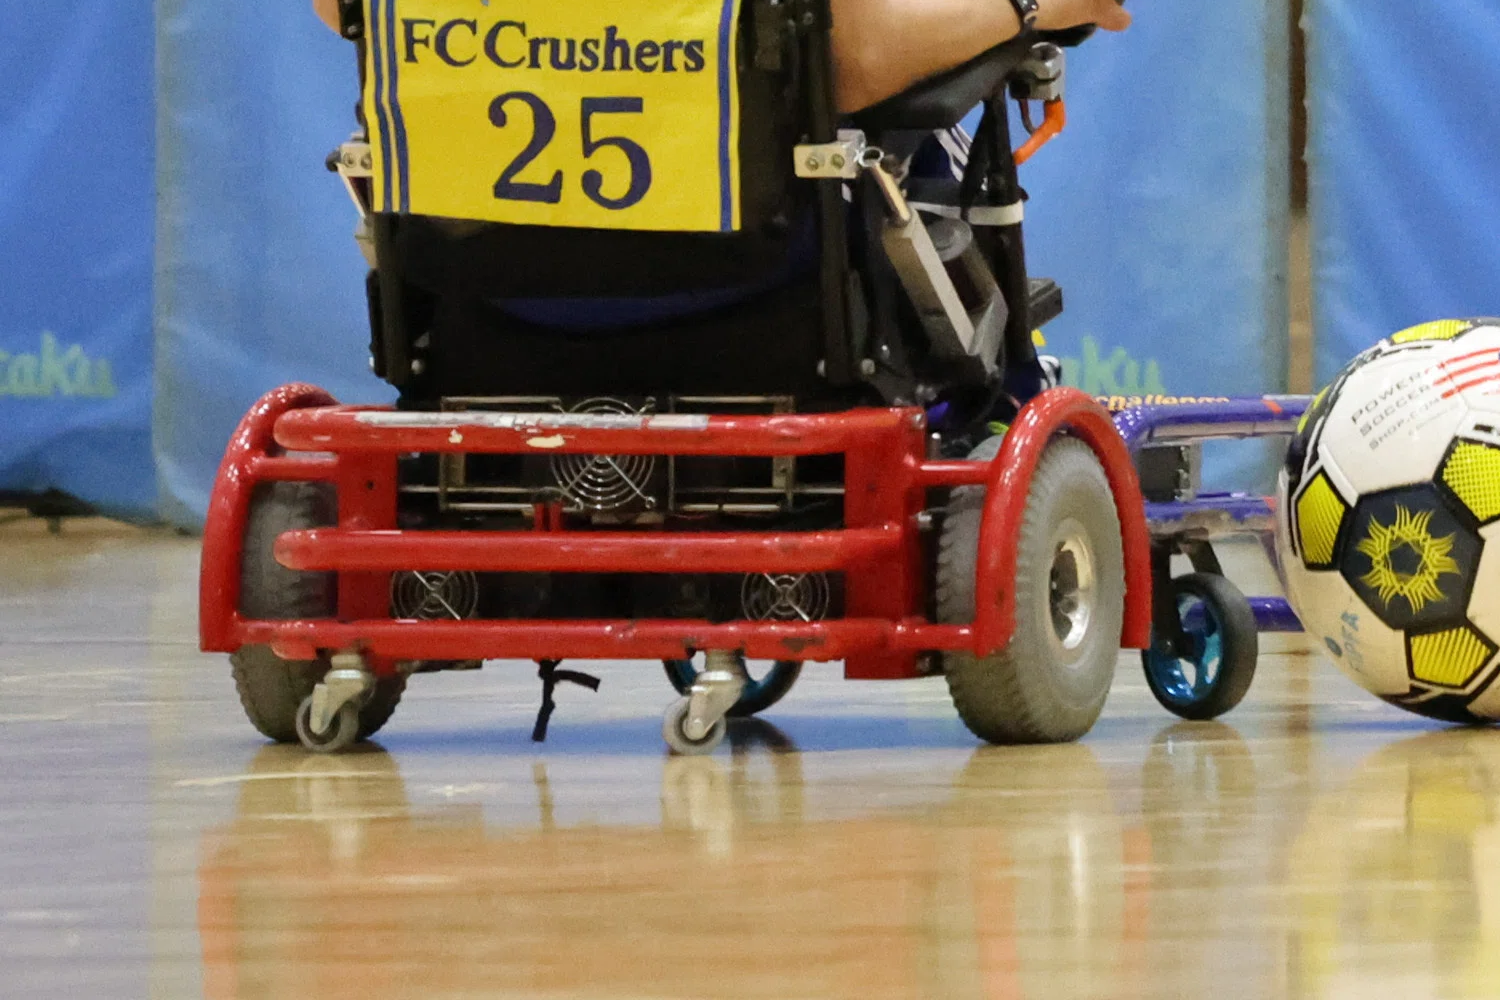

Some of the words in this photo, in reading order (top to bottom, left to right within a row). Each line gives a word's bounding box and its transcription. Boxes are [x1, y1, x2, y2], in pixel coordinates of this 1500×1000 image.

[488, 90, 652, 210] 25
[1351, 371, 1421, 425] POWER
[1360, 384, 1431, 437] SOCCER
